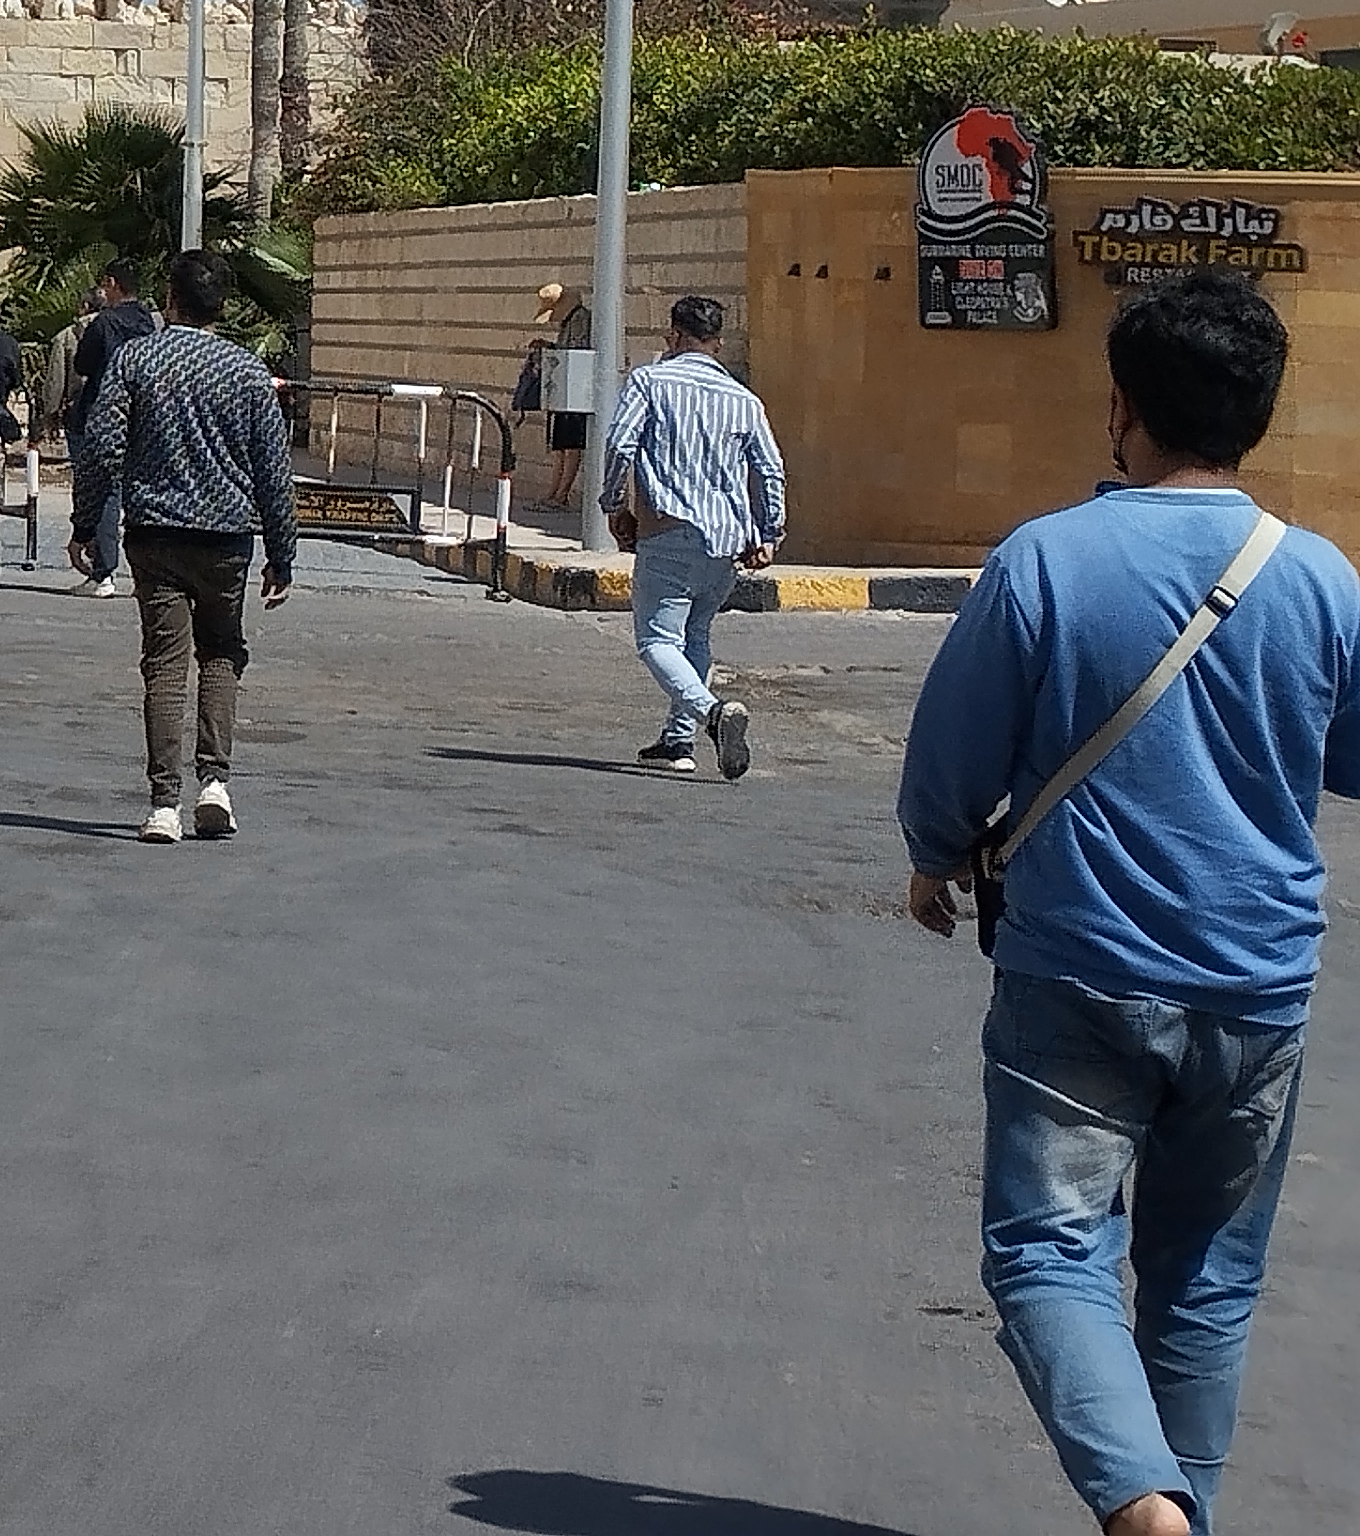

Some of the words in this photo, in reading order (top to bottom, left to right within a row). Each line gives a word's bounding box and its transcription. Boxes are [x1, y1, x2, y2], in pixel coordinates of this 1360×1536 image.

[1100, 204, 1174, 233] فارم
[1180, 204, 1275, 240] تبارك
[1077, 234, 1199, 265] Tbarak
[1207, 239, 1302, 270] Farm
